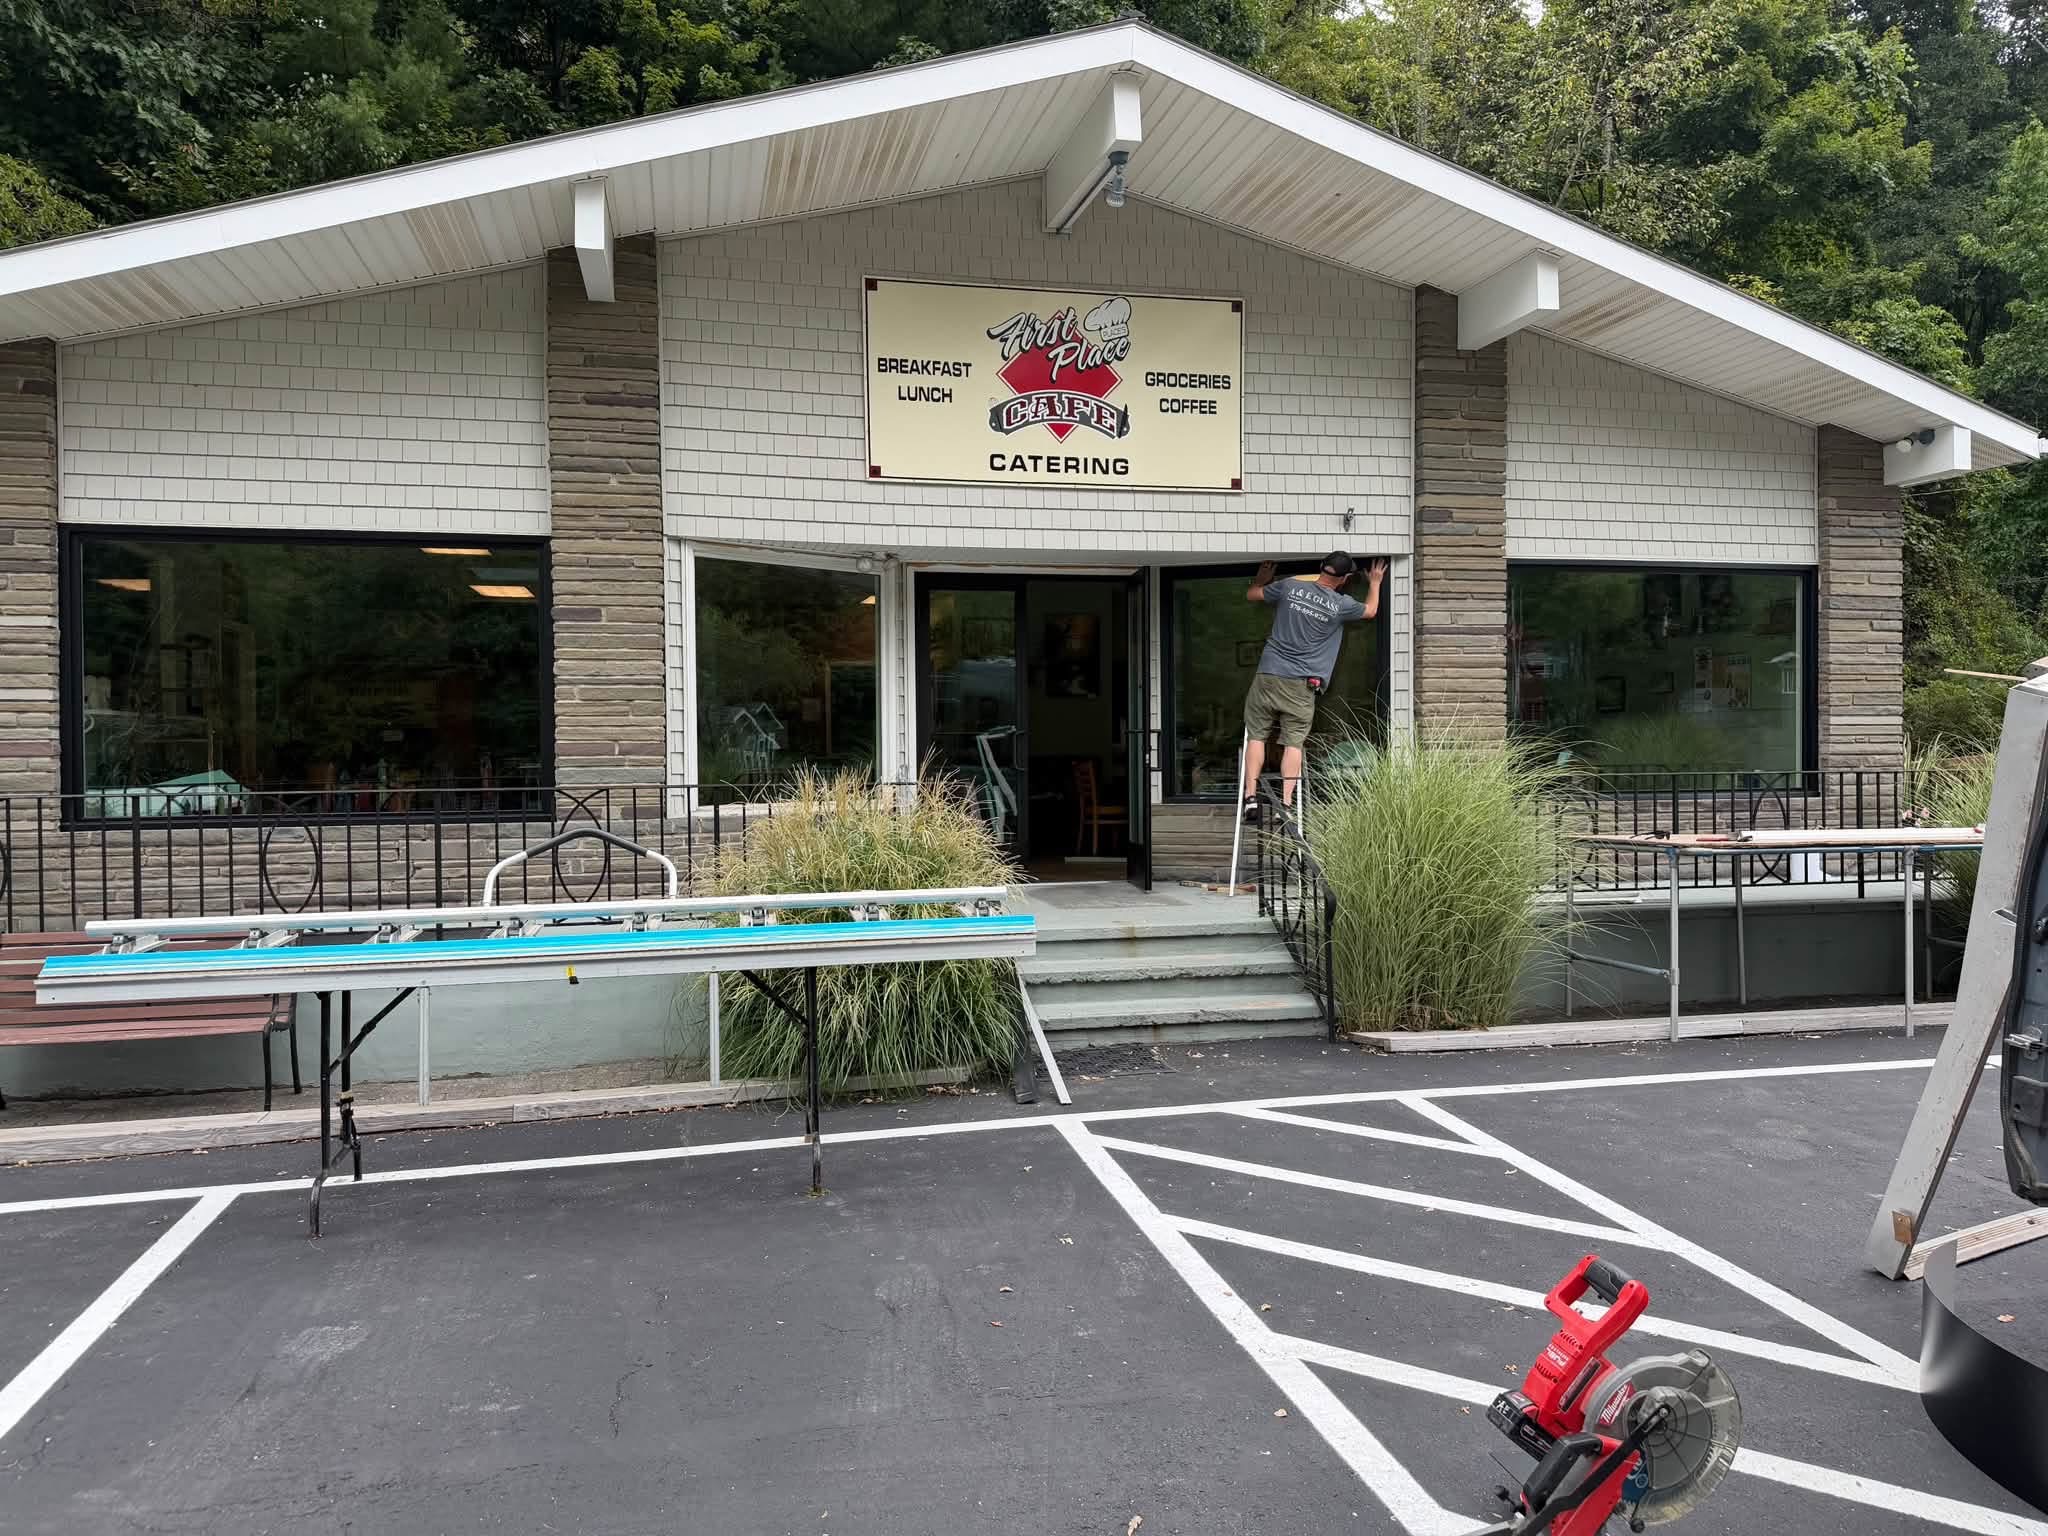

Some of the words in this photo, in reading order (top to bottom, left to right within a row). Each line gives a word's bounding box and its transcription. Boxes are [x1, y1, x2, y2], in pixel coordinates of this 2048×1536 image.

[987, 307, 1077, 361] First
[877, 357, 973, 378] BREAKFAST
[1046, 337, 1131, 384] Place
[1144, 371, 1232, 390] GROCERIES
[897, 385, 953, 404] LUNCH
[1003, 393, 1118, 437] CAFE
[1159, 398, 1218, 415] COFFEE
[988, 453, 1130, 476] CATERING
[1313, 595, 1339, 612] GLASS
